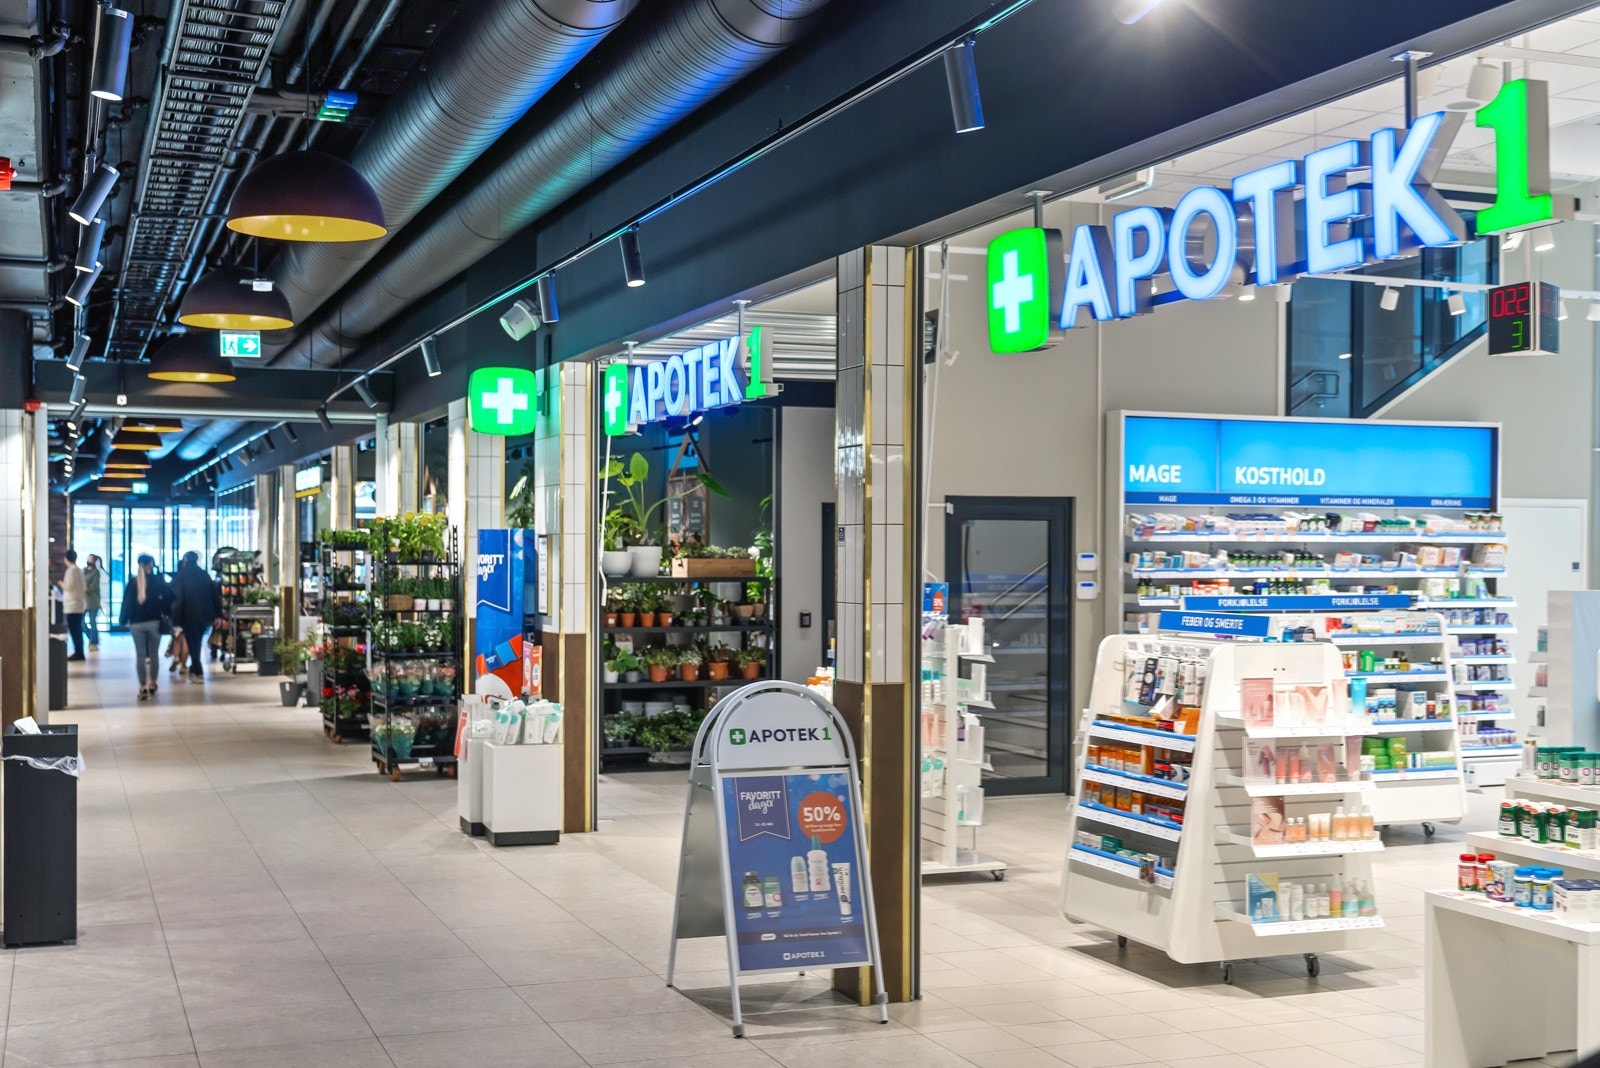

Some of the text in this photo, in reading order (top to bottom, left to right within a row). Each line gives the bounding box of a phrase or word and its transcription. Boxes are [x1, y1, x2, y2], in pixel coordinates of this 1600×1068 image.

[1059, 78, 1553, 330] APOTEK 1
[1492, 285, 1529, 318] 022
[1511, 320, 1523, 349] 3
[630, 325, 766, 425] APOTEK 1
[1129, 464, 1182, 483] MAGE
[1235, 466, 1326, 486] KOSTHOLD
[1158, 495, 1178, 503] MAGE
[1229, 496, 1251, 504] OMEGA
[1267, 496, 1299, 504] VITAMINER
[1320, 497, 1351, 505] VITAMINER
[1218, 598, 1268, 607] FORKJØLELSE
[1332, 597, 1379, 606] FORKJØLELSE
[1181, 616, 1244, 630] FEBER OG SMERTE
[749, 727, 832, 743] APOTEK 1
[740, 790, 781, 801] FAVORITT
[748, 799, 774, 815] dager
[803, 805, 842, 822] 50%
[791, 952, 820, 960] APOTEK
